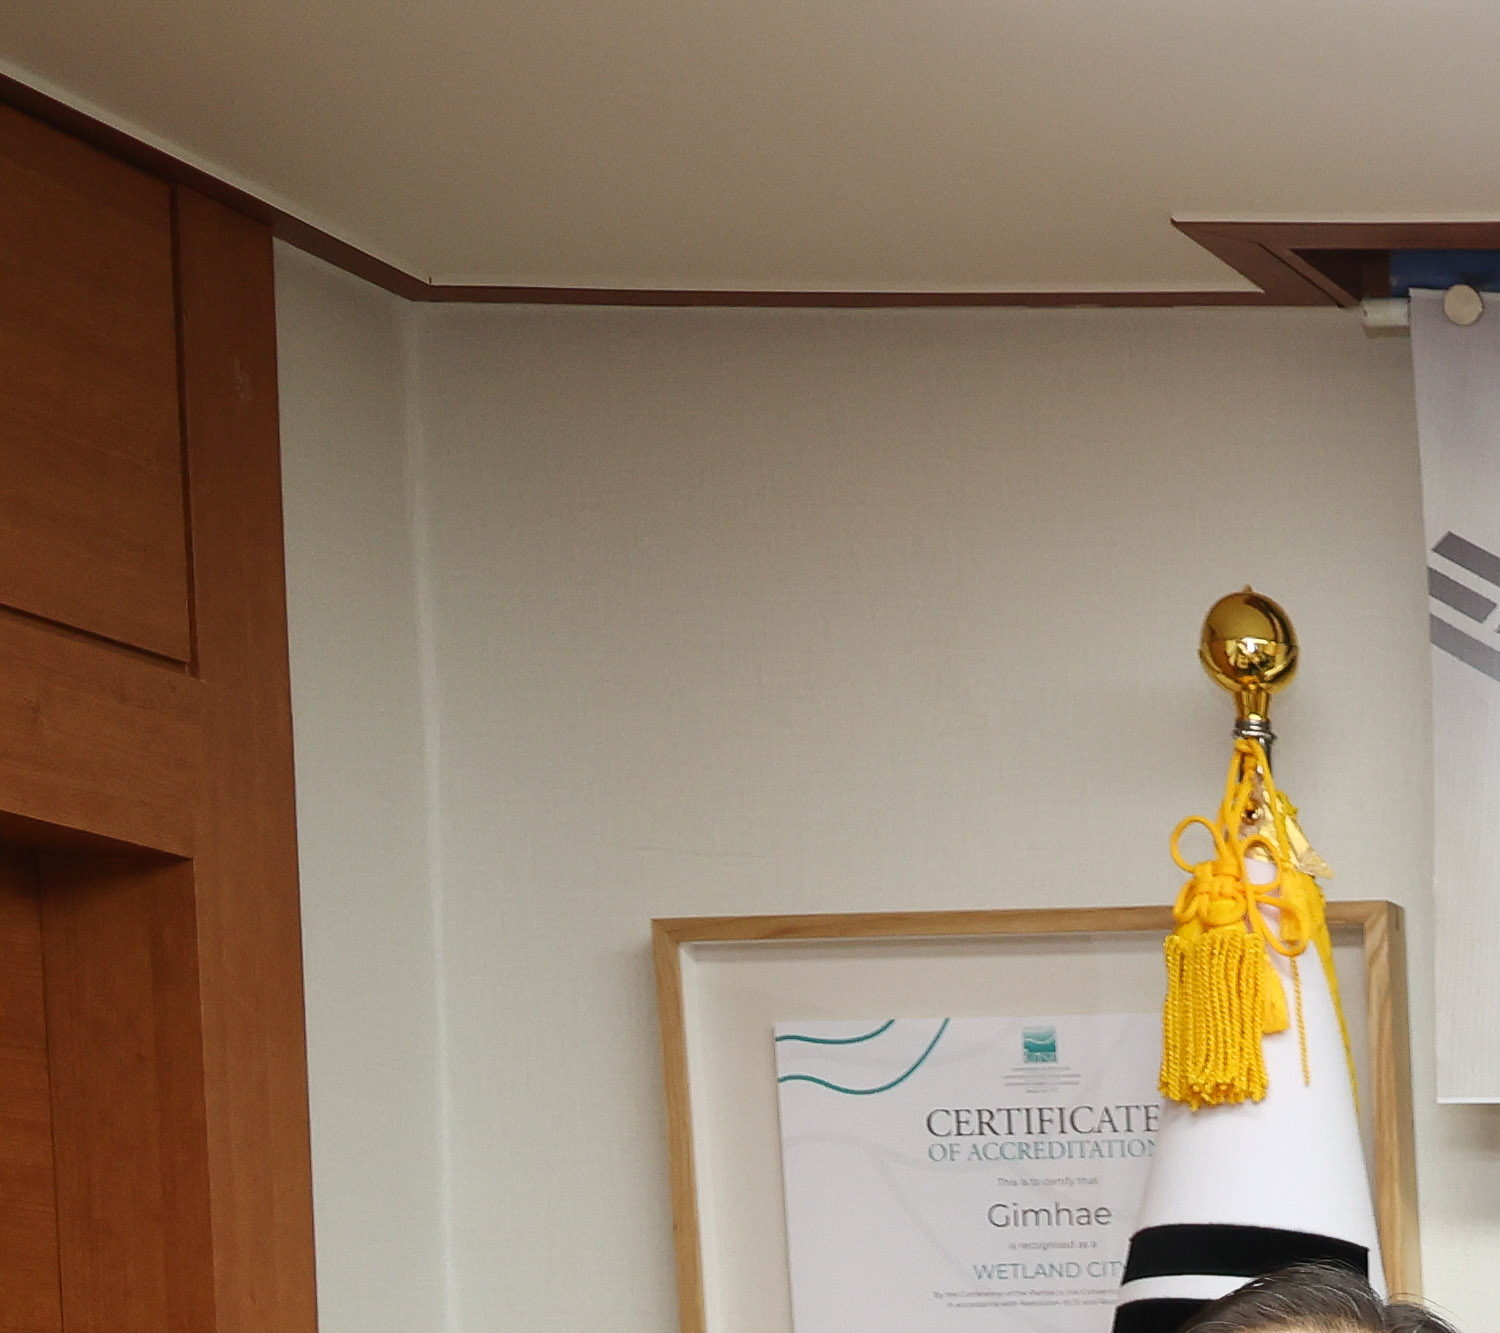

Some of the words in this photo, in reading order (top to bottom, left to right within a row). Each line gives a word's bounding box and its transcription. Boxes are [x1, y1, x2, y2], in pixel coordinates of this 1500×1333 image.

[926, 1103, 1160, 1138] CERTIFICATE
[928, 1143, 960, 1162] OF
[987, 1202, 1113, 1228] Gimhae
[973, 1263, 1081, 1280] WETLAND
